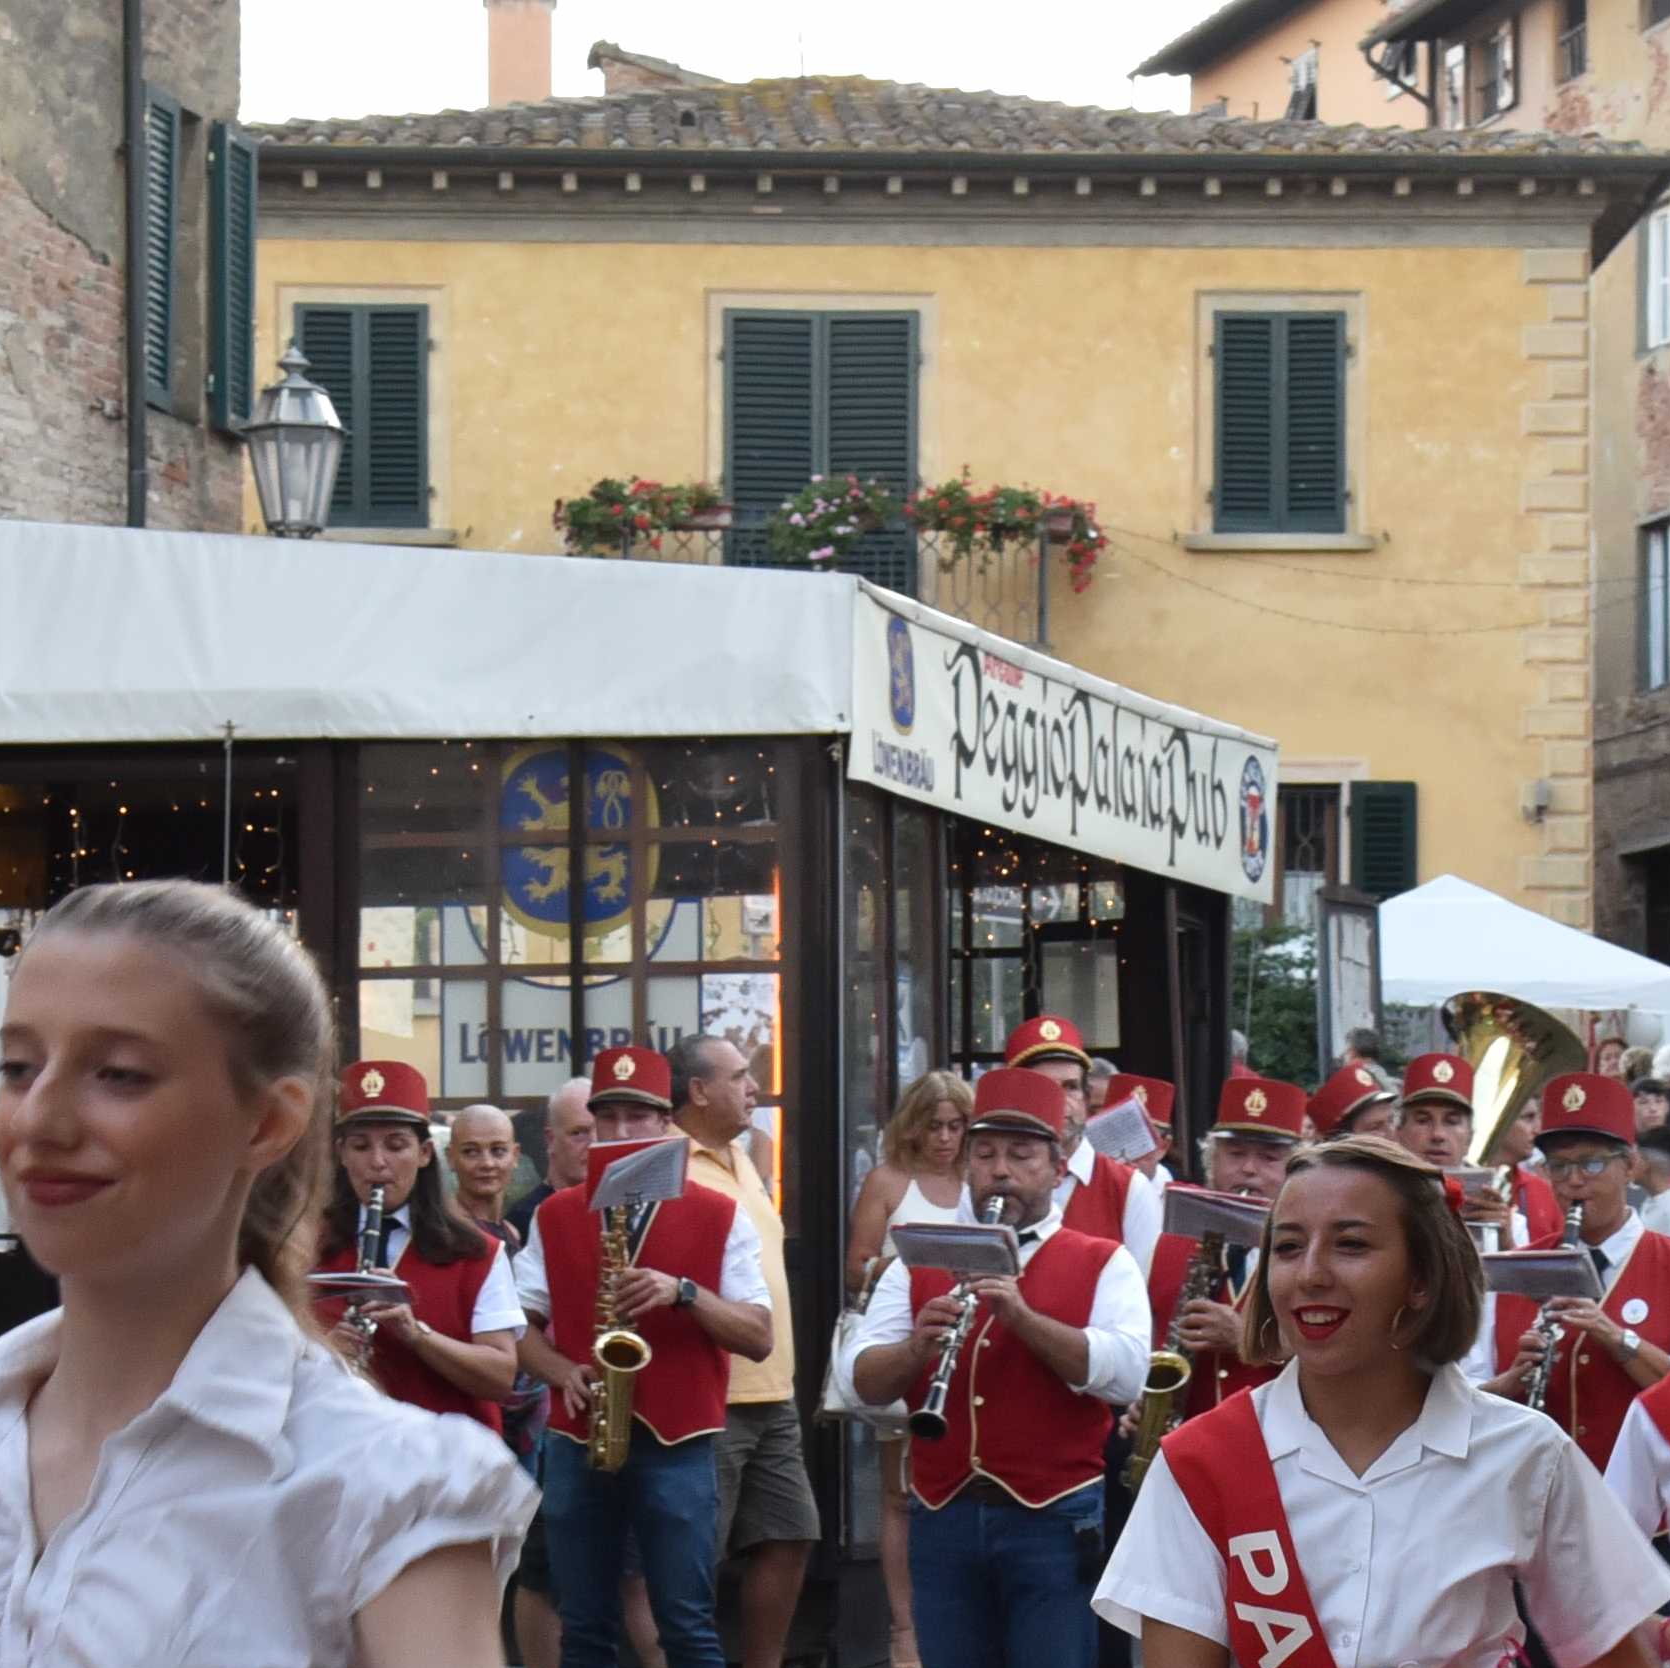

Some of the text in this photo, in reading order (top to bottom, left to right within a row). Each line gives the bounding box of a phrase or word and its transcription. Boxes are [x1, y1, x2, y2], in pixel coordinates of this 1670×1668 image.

[944, 642, 1228, 867] Peggio Palaia Pub
